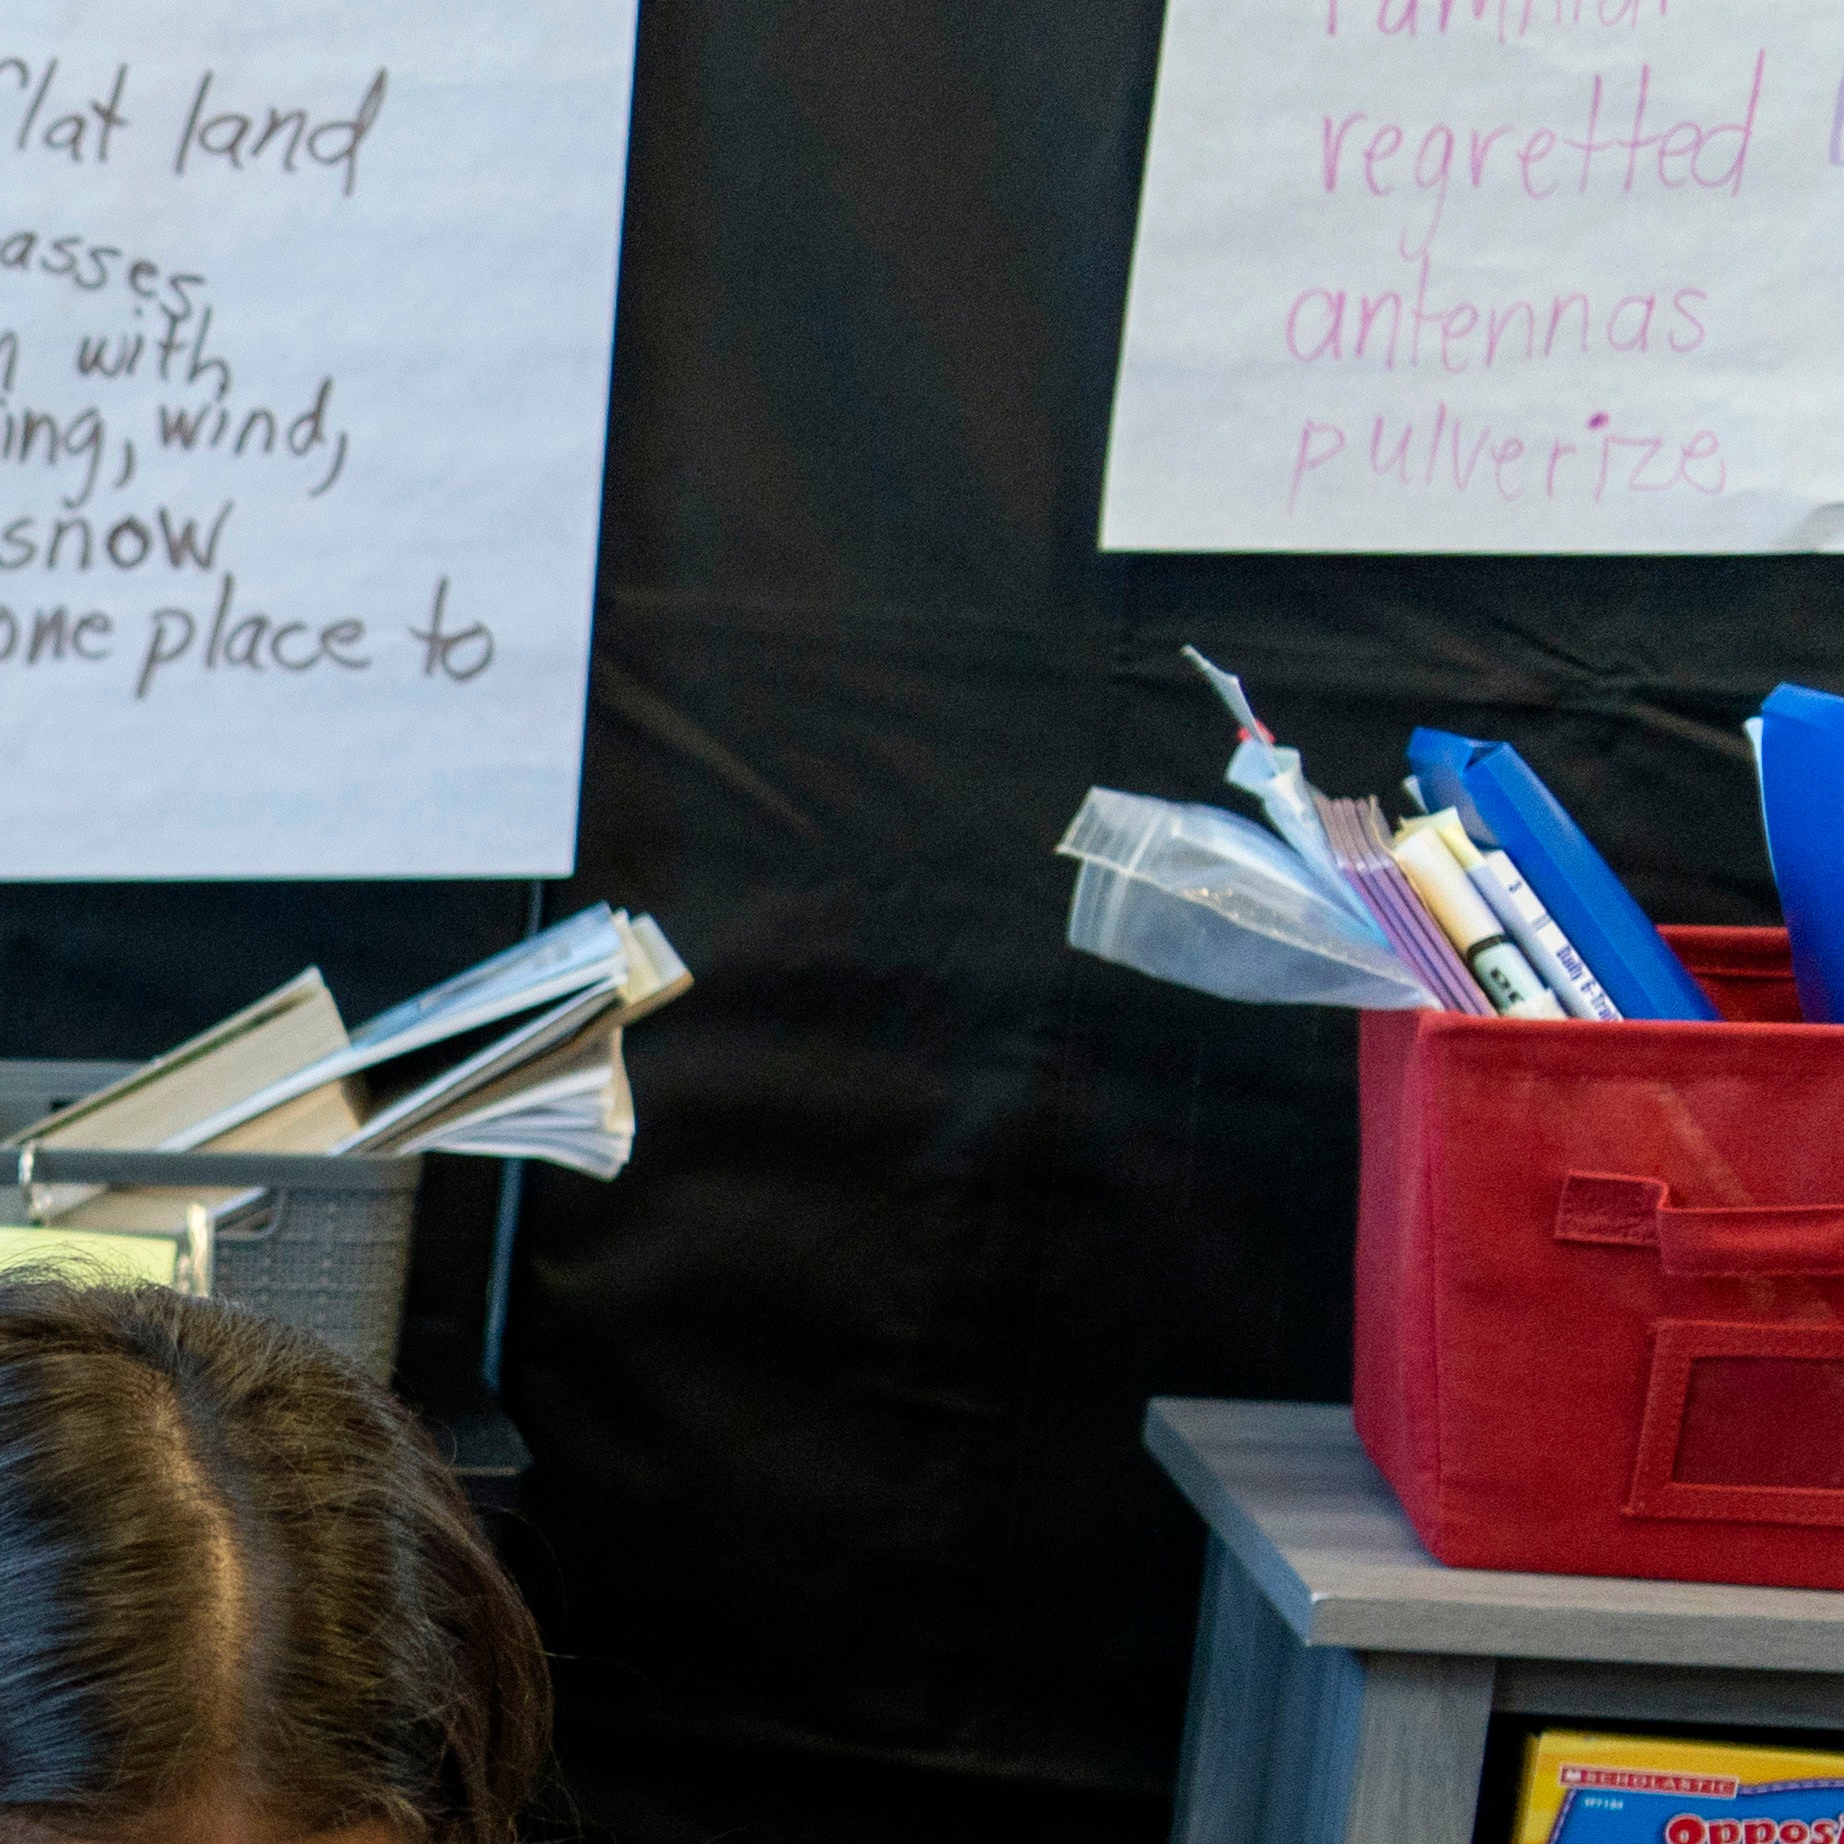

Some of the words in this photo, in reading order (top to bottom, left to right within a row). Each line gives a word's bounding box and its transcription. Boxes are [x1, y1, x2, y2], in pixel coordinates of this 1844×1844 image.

[174, 66, 388, 197] land
[1321, 48, 1767, 260] regretted
[77, 303, 232, 400] with
[1285, 250, 1709, 375] antennas
[157, 377, 347, 497] wind,
[1287, 401, 1728, 517] pulverize
[134, 572, 375, 701] place
[409, 576, 495, 683] to
